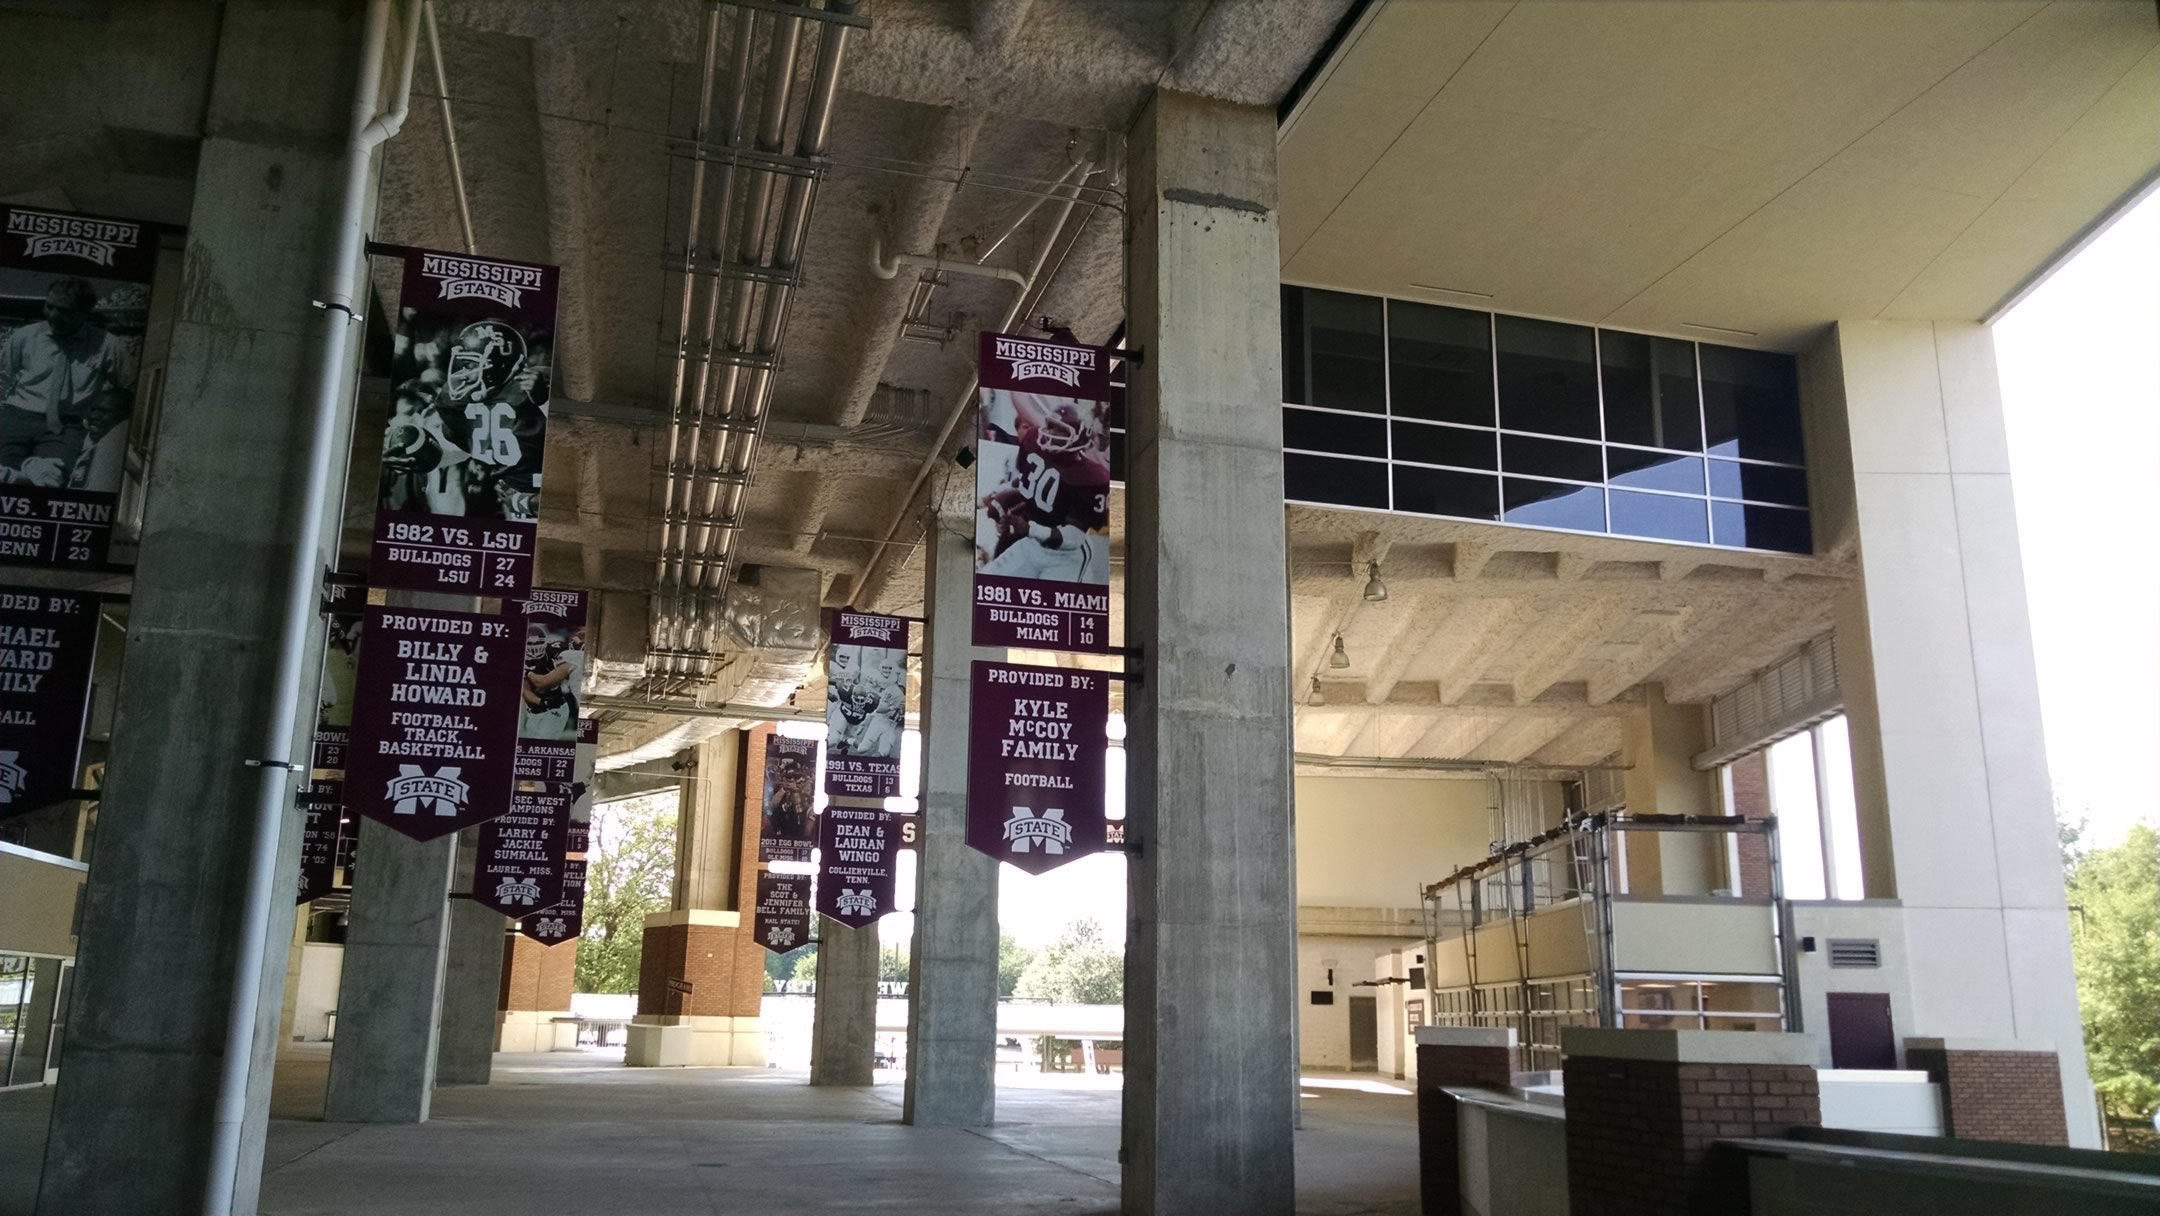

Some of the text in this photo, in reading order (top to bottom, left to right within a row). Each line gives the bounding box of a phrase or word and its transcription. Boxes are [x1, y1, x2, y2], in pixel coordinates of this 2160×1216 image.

[7, 213, 140, 243] MISSISSIPPI
[40, 240, 99, 260] STATE
[422, 257, 543, 287] MISSISSIPPI
[453, 282, 508, 302] STATE
[996, 341, 1096, 367] MISSISSIPPI
[1024, 364, 1068, 381] STATE
[464, 402, 522, 467] 26
[1019, 453, 1060, 513] 30
[0, 496, 112, 522] VS. TENN
[1093, 494, 1108, 513] 3
[0, 523, 92, 543] DOGS 27
[387, 522, 523, 550] 1982 VS. LSU
[0, 541, 90, 560] ENN 23
[388, 548, 515, 571] BULLDOGS 27
[438, 569, 515, 588] LSU 24
[0, 594, 80, 614] DED BY:
[531, 592, 579, 604] SISSIPPI
[977, 585, 1108, 611] 1981 VS. MIAMI
[529, 604, 560, 613] STATE
[381, 614, 510, 638] PROVIDED BY:
[841, 615, 900, 629] MISSISSIPPI
[990, 609, 1094, 629] BULLDOGS 14
[0, 626, 60, 648] HAEL
[857, 628, 883, 638] STATE
[1016, 627, 1094, 644] MIAMI 10
[397, 640, 489, 664] BILLY &
[0, 649, 54, 671] ARD
[405, 662, 477, 685] LINDA
[988, 669, 1094, 690] PROVIDED BY:
[0, 672, 43, 693] ILY
[390, 683, 486, 707] HOWARD
[1014, 698, 1068, 719] KYLE
[0, 710, 36, 726] ALL
[391, 711, 478, 731] FOOTBALL,
[314, 731, 349, 742] BOWL
[404, 728, 463, 744] TRACK,
[328, 746, 340, 755] 23
[378, 741, 485, 760] BASKETBALL
[516, 745, 576, 756] S. ARKANSAS
[1001, 739, 1079, 761] FAMILY
[326, 756, 338, 764] 20
[515, 758, 568, 768] LDOGS 22
[514, 768, 565, 777] ANSAS 21
[848, 761, 865, 772] VS.
[868, 763, 900, 774] TEXAS
[832, 774, 894, 785] BULLDOGS 13
[1005, 773, 1074, 789] FOOTBALL
[318, 785, 334, 794] BY:
[400, 780, 455, 798] STATE
[845, 784, 872, 793] TEXAS
[514, 796, 565, 806] SEC WEST
[511, 805, 554, 814] AMPIONS
[831, 810, 892, 821] PROVIDED BY:
[305, 812, 321, 824] TT
[542, 818, 556, 826] BY:
[304, 831, 319, 839] ON
[498, 828, 549, 839] LARRY &
[836, 825, 884, 837] DEAN &
[1015, 821, 1060, 838] STATE
[502, 839, 543, 850] JACKIE
[779, 839, 792, 847] EGG
[793, 840, 814, 848] BOWL
[834, 837, 885, 850] LAURAN
[494, 850, 548, 861] SUMRALL
[839, 850, 880, 862] WINGO
[529, 866, 553, 875] MISS.
[828, 866, 888, 877] COLLIERVILLE,
[563, 879, 581, 887] TION
[776, 883, 793, 891] THE
[845, 876, 870, 884] TENN.
[503, 886, 533, 896] STATE
[770, 891, 789, 899] SCOT
[764, 899, 803, 907] JENNIFER
[843, 896, 870, 905] STATE
[780, 907, 810, 915] FAMILY
